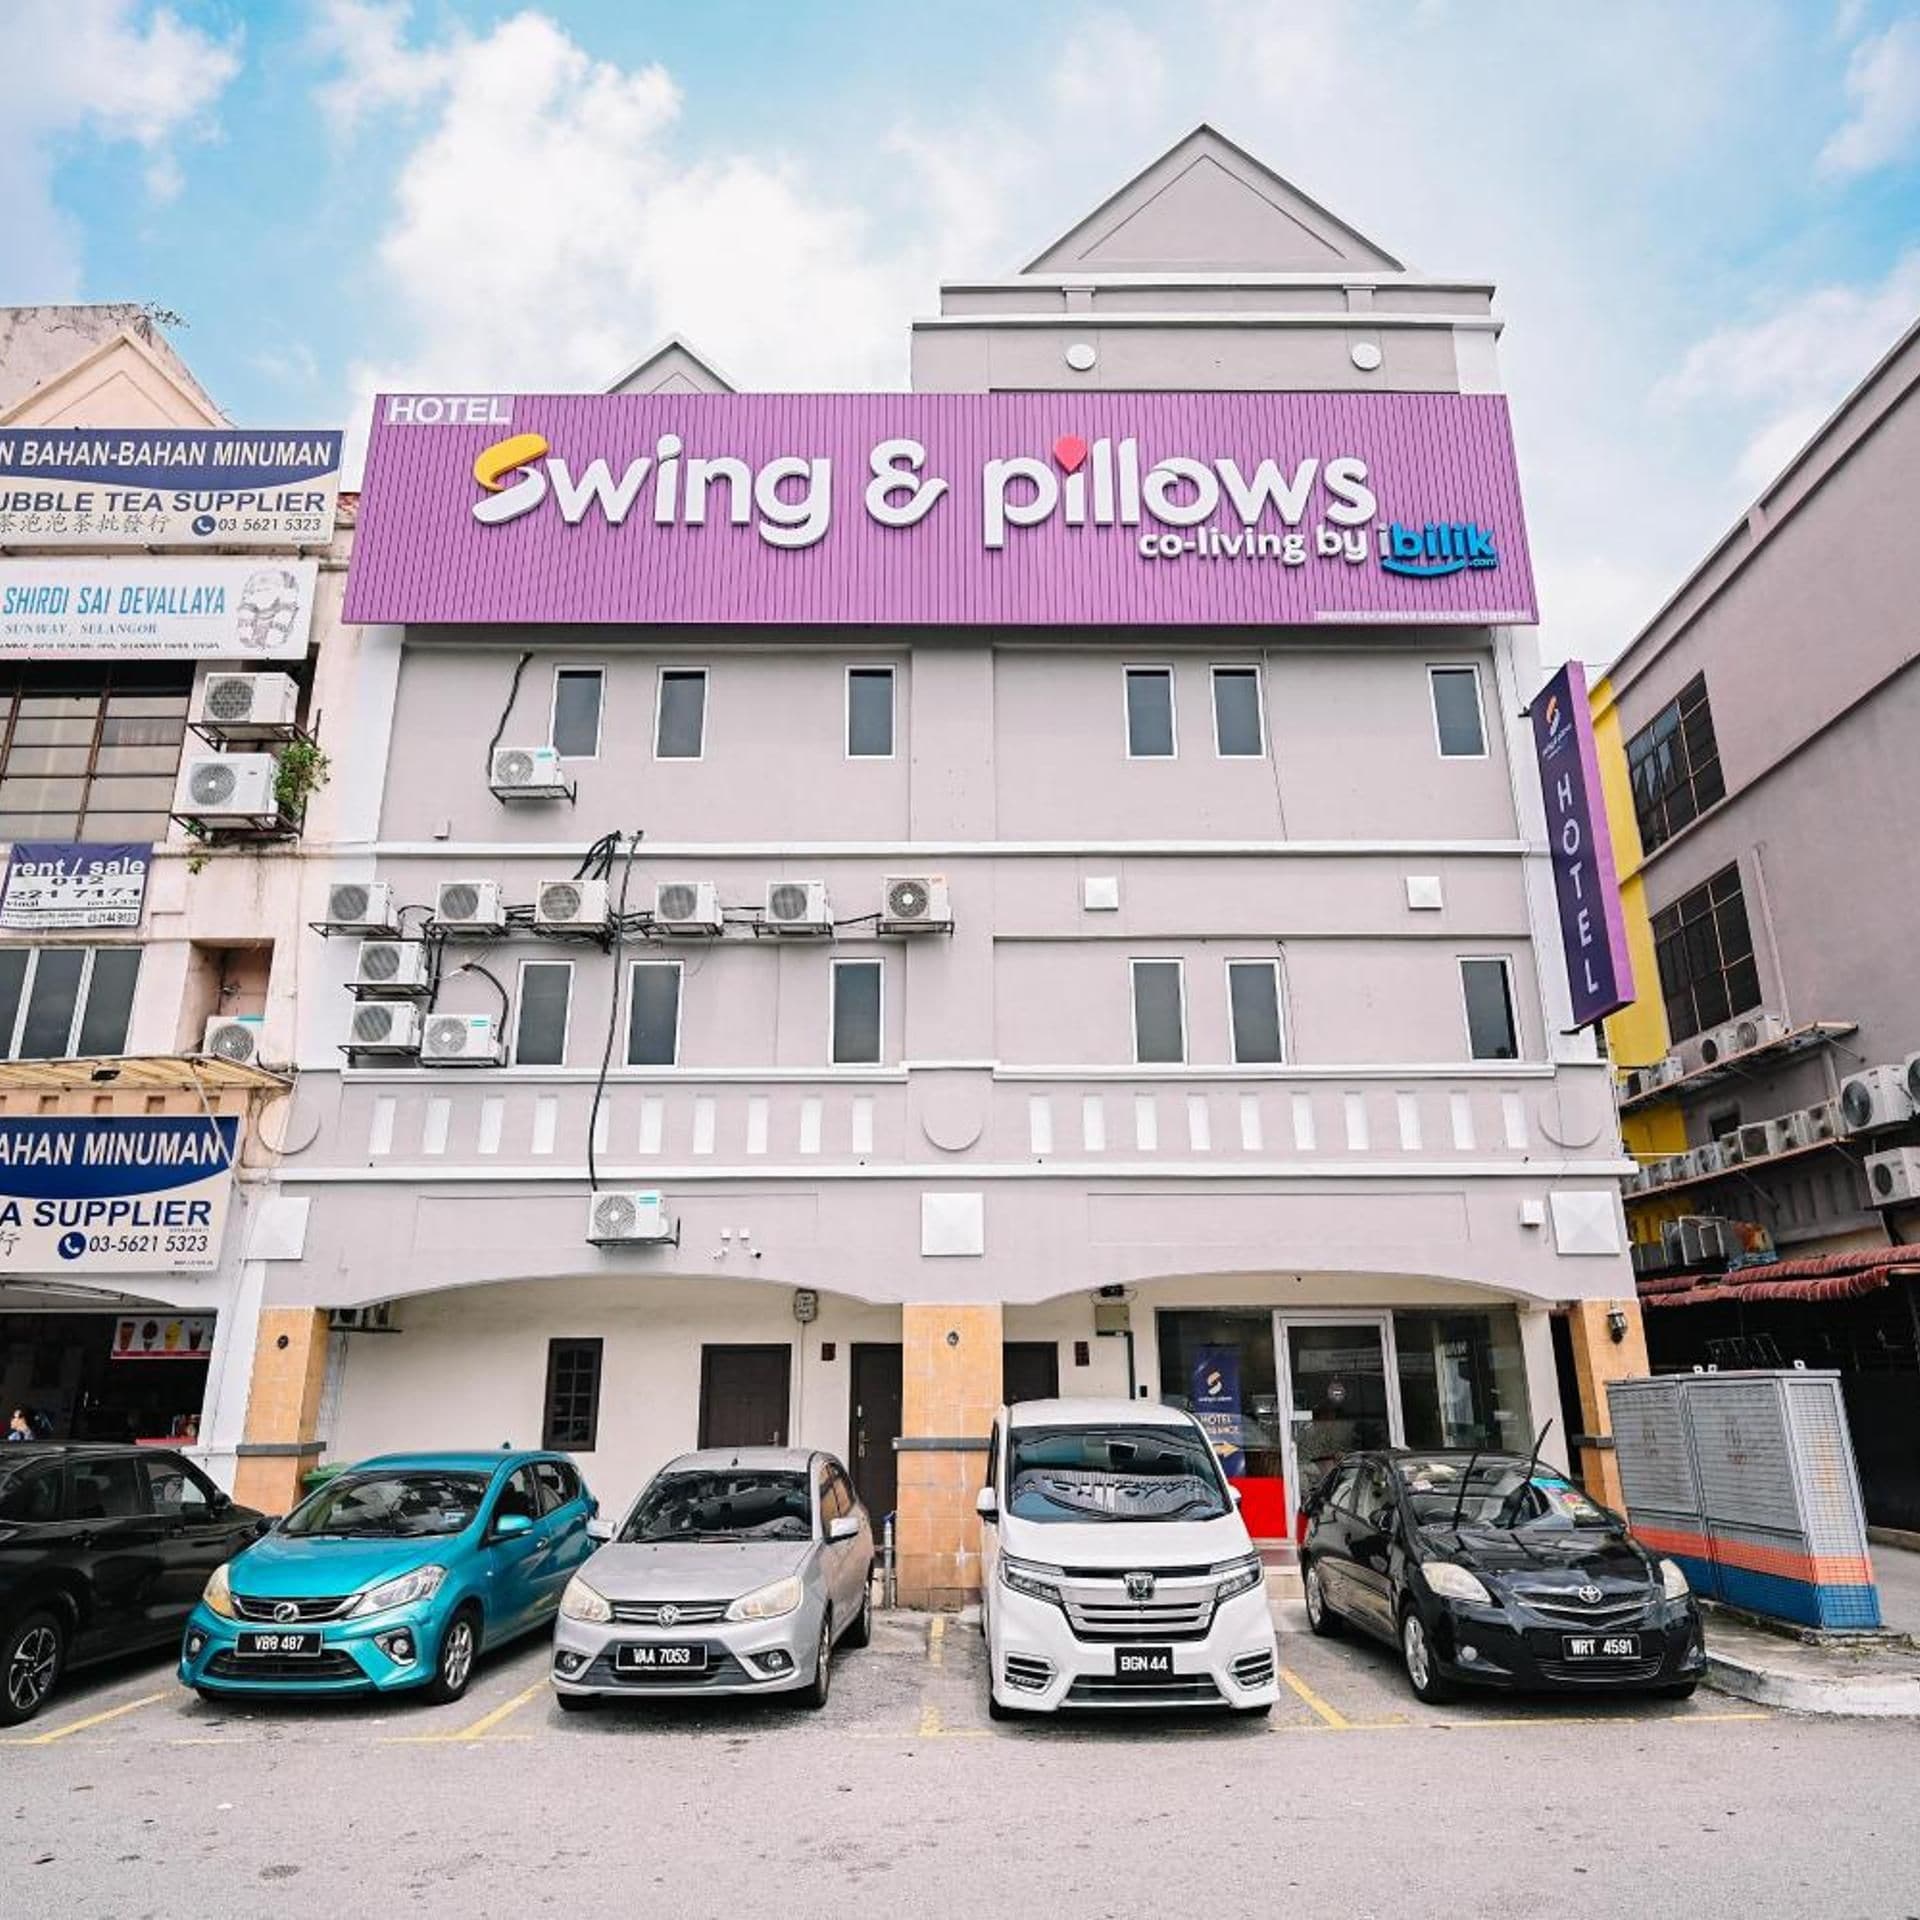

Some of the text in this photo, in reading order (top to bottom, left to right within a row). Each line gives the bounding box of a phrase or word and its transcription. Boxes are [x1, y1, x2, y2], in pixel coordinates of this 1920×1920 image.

[388, 396, 510, 424] HOTEL
[20, 441, 206, 466] BAHAN-BAHAN
[212, 441, 331, 467] MINUMAN
[105, 492, 164, 512] TEA
[172, 491, 325, 512] SUPPLIER
[472, 432, 1377, 548] Swing & pillows
[218, 518, 321, 532] 03 5621 5323
[1138, 521, 1497, 566] co-living by ibilik
[3, 586, 225, 614] SHIRDI SAI DEVALLAYA
[10, 858, 65, 876] rent
[89, 857, 146, 876] sale
[1557, 773, 1599, 995] HOTEL
[82, 1132, 219, 1165] MINUMAN
[0, 1201, 212, 1227] A SUPPLIER
[89, 1236, 209, 1252] 03-5621 5323
[281, 1635, 304, 1650] 487
[1571, 1639, 1633, 1654] WRT 4591
[659, 1648, 690, 1664] 7053
[1121, 1656, 1168, 1671] BGN 44
